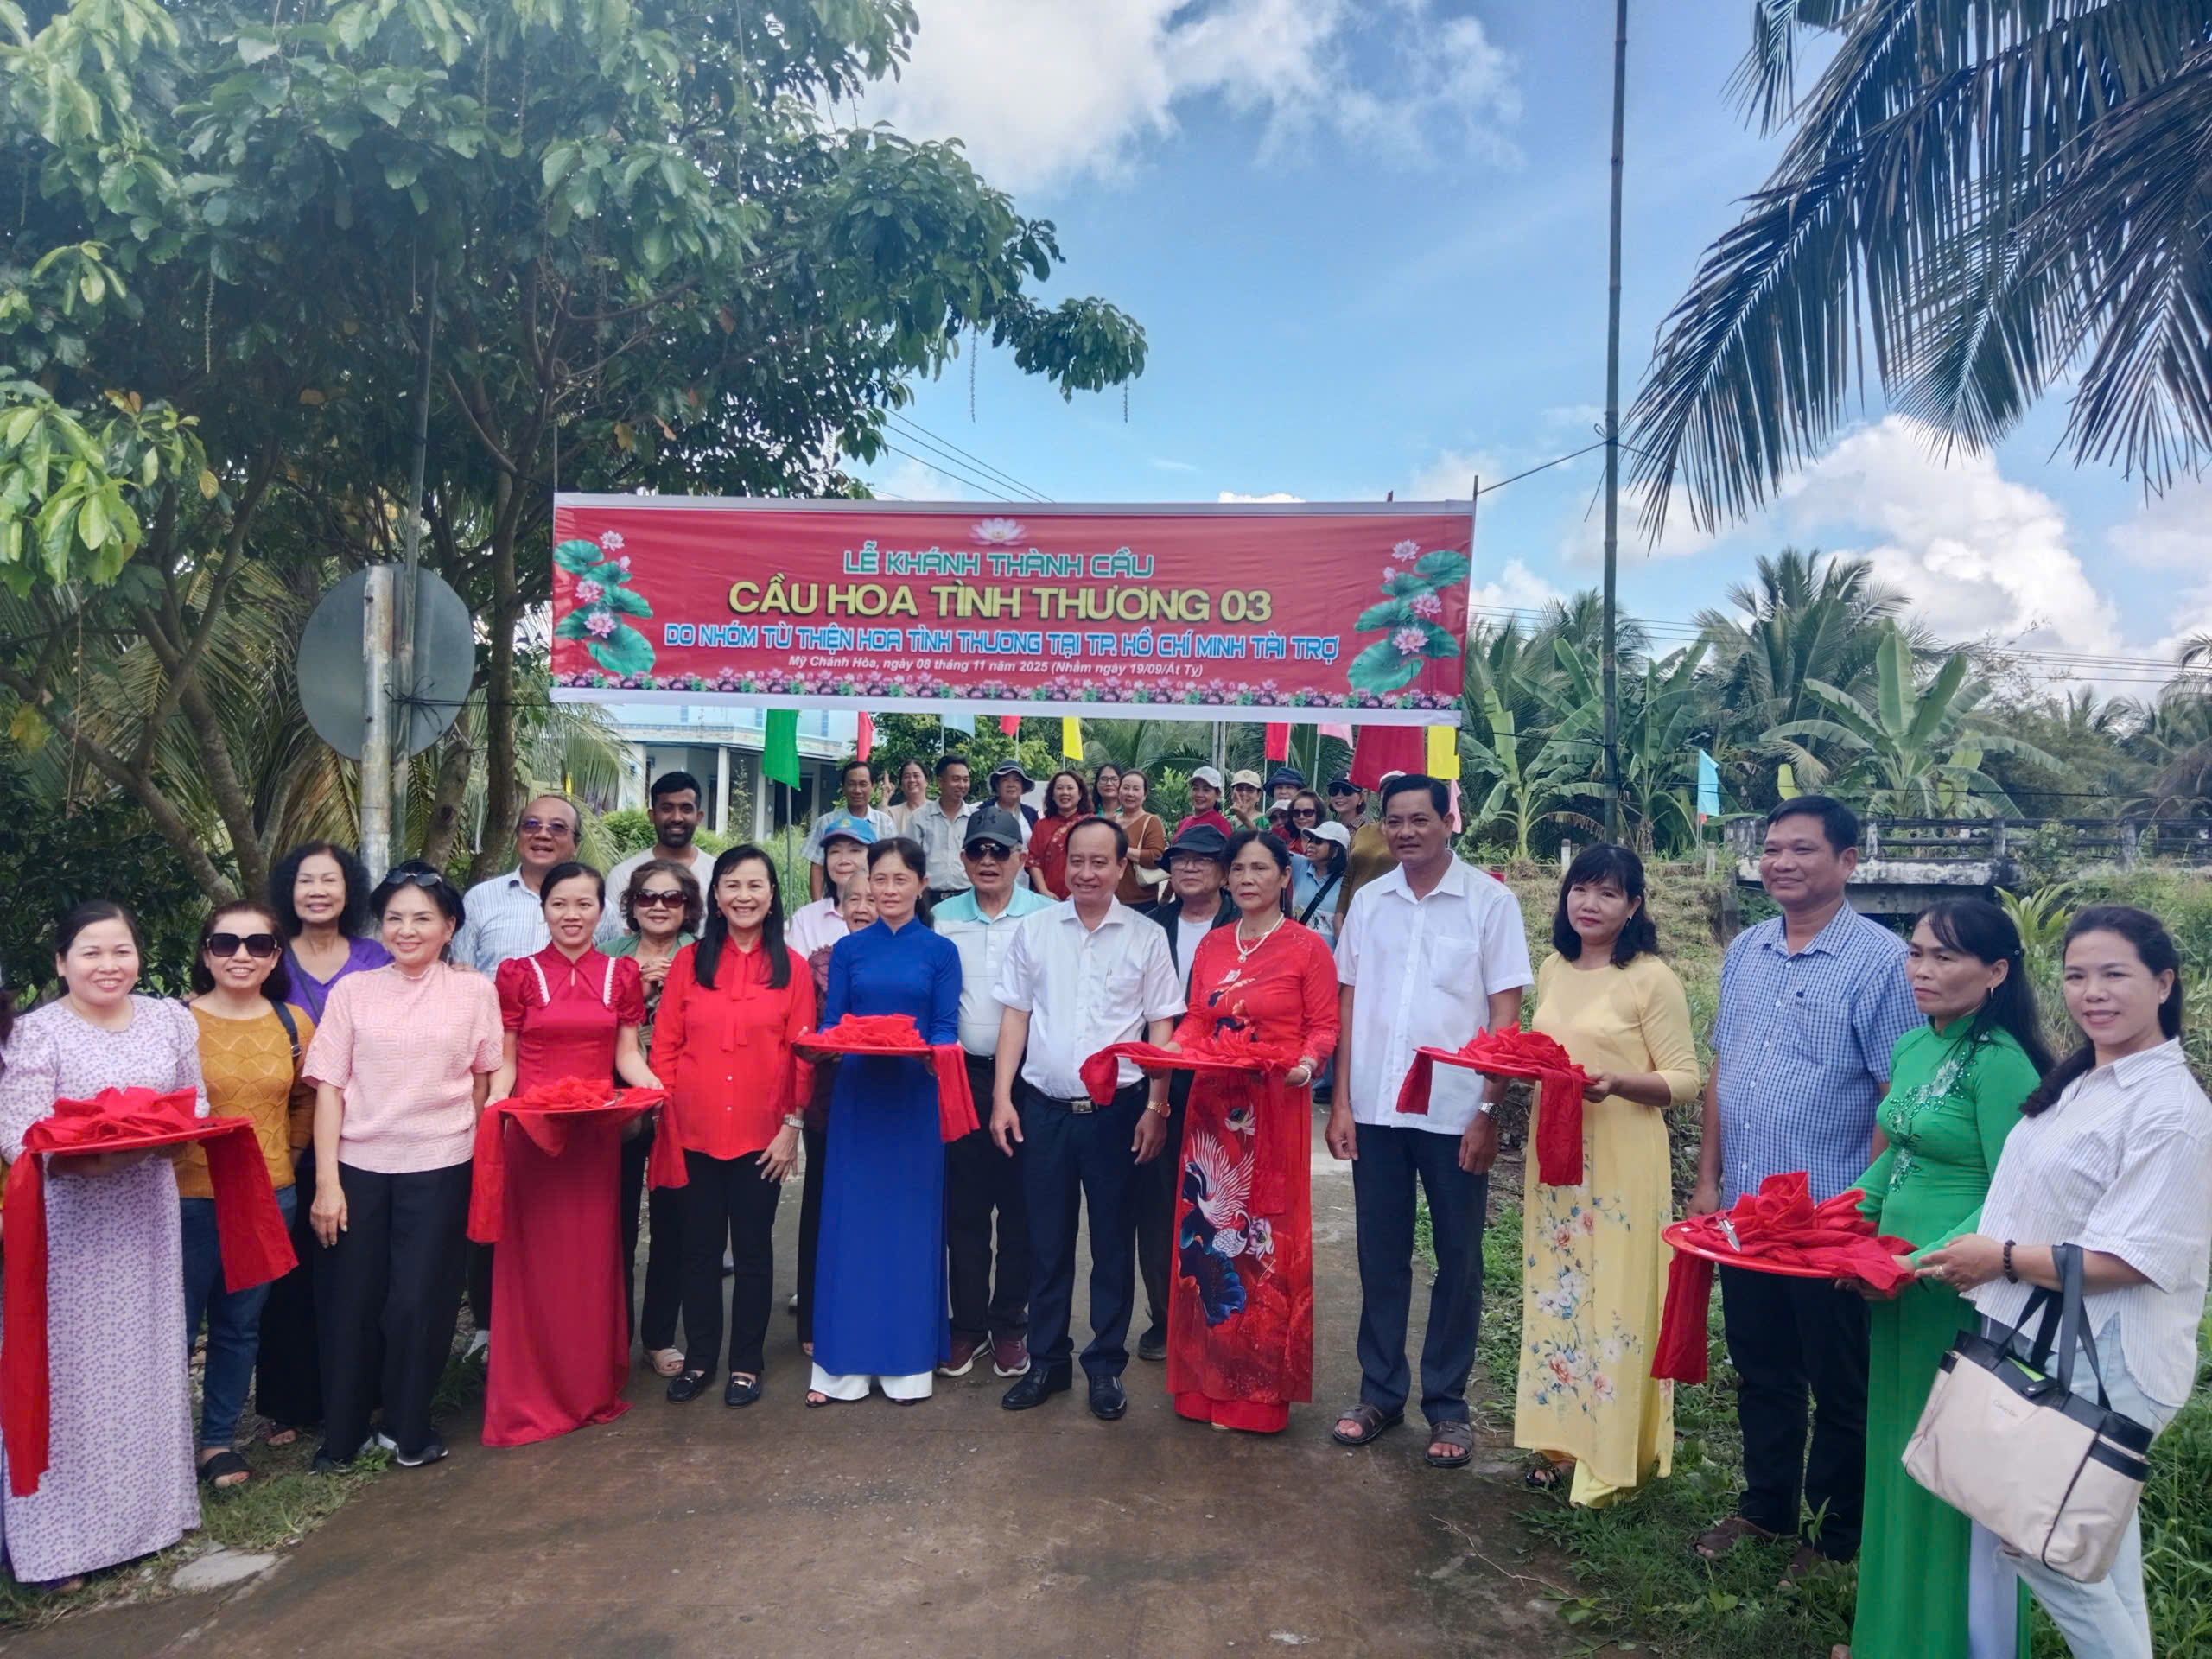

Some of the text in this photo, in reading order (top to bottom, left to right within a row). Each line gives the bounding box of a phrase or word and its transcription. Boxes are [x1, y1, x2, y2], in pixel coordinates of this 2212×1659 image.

[843, 540, 1154, 578] LỄ KHÁNH THÀNH CẦU
[728, 572, 1272, 622] CẦU HOA TÌNH THƯƠNG 03
[664, 620, 1340, 665] DO NHÓM TỪ THIỆN HOA TÌNH THƯƠNG TẠI TP. HỒ CHÍ MINH TÀI TRỢ
[789, 655, 807, 668] Mỹ
[810, 656, 849, 667] Chánh
[852, 658, 880, 670] Hòa,
[883, 658, 913, 671] ngày
[916, 658, 931, 670] 08
[934, 659, 969, 672] tháng
[973, 660, 985, 671] 11
[988, 661, 1015, 671] năm
[1020, 661, 1048, 672] 2025
[1095, 663, 1126, 676] ngày
